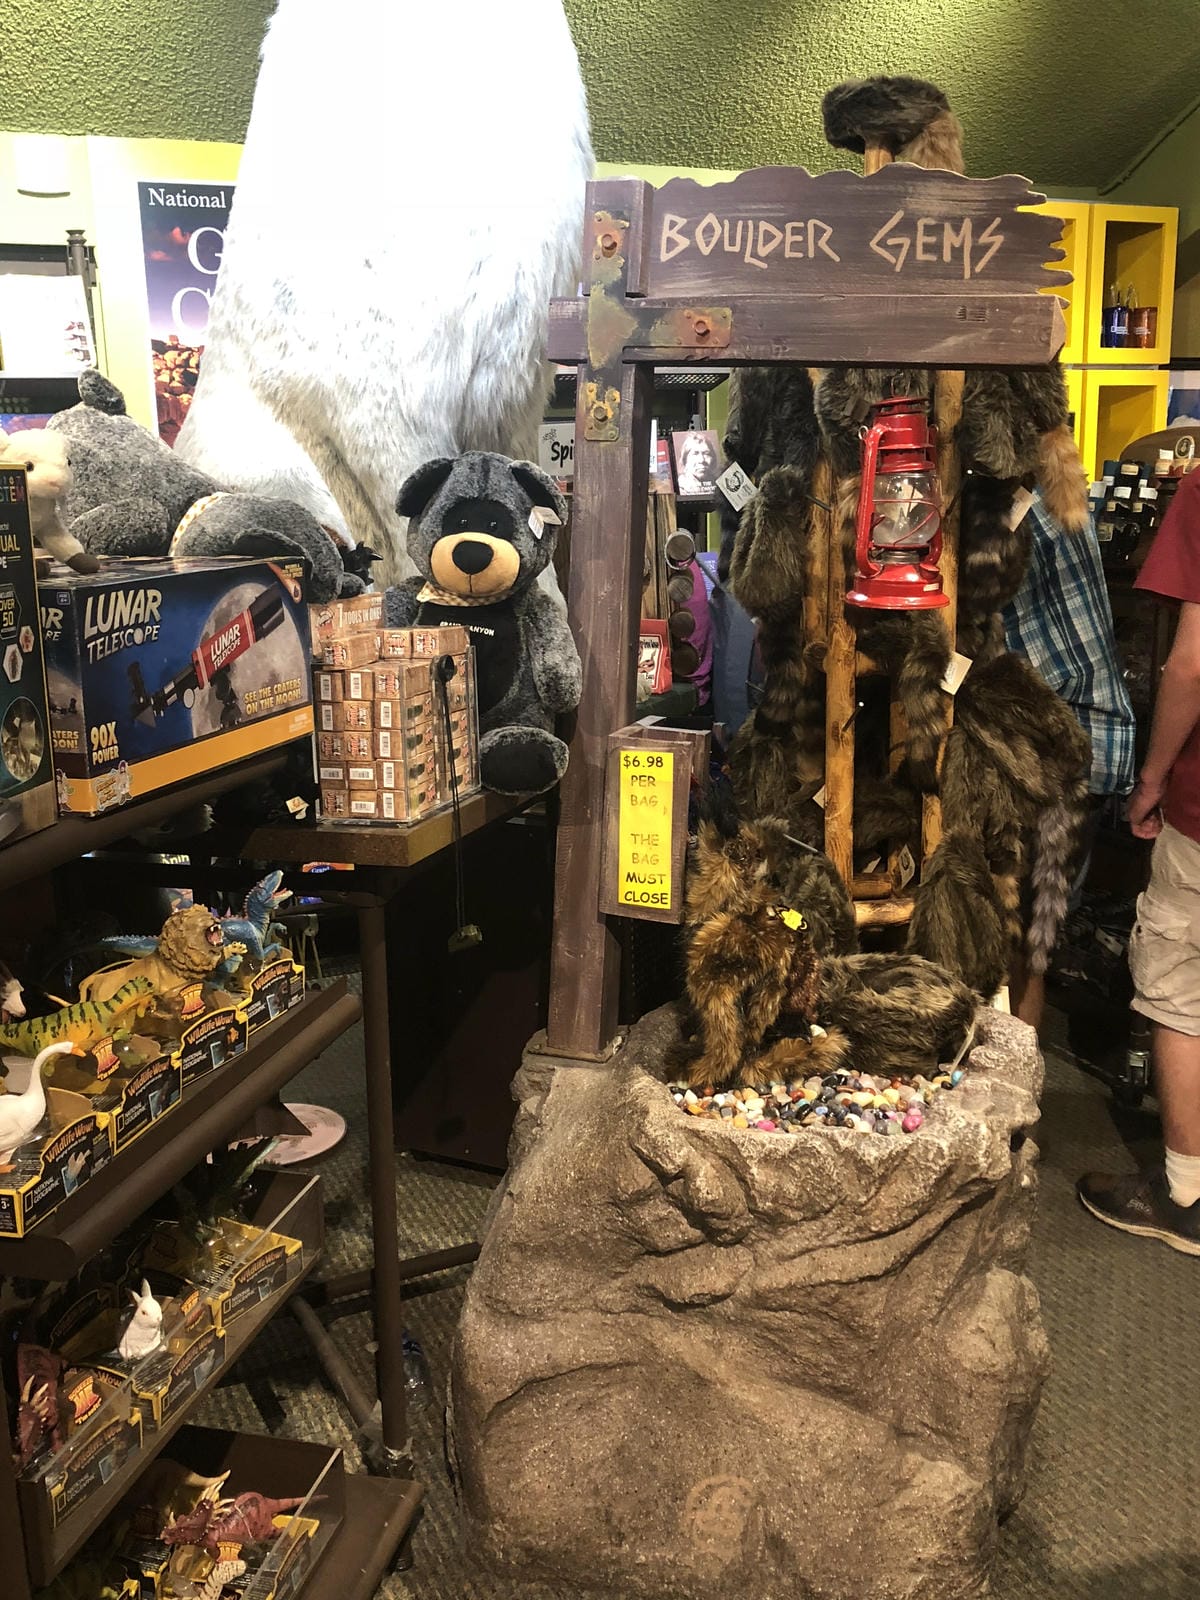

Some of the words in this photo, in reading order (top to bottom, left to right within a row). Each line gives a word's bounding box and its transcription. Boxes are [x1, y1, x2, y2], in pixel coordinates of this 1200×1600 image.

[148, 188, 226, 208] National
[660, 212, 841, 270] BOULDER
[868, 210, 1005, 280] GEMS
[3, 611, 14, 627] 50
[84, 589, 162, 640] LUNAR
[87, 625, 161, 665] TELESCOPE
[210, 623, 241, 661] LUNAR
[213, 637, 241, 671] TELESCOPE
[244, 690, 257, 704] SEE
[258, 686, 272, 699] THE
[273, 678, 302, 695] CRATERS
[246, 704, 258, 716] ON
[260, 700, 274, 711] THE
[275, 690, 302, 707] MOON!
[91, 721, 118, 751] 90X
[92, 745, 120, 766] POWER
[623, 754, 664, 770] $6.98
[630, 774, 656, 788] PER
[630, 794, 658, 807] BAG
[630, 833, 660, 847] THE
[632, 852, 660, 866] BAG
[626, 871, 666, 885] MUST
[624, 890, 669, 905] CLOSE
